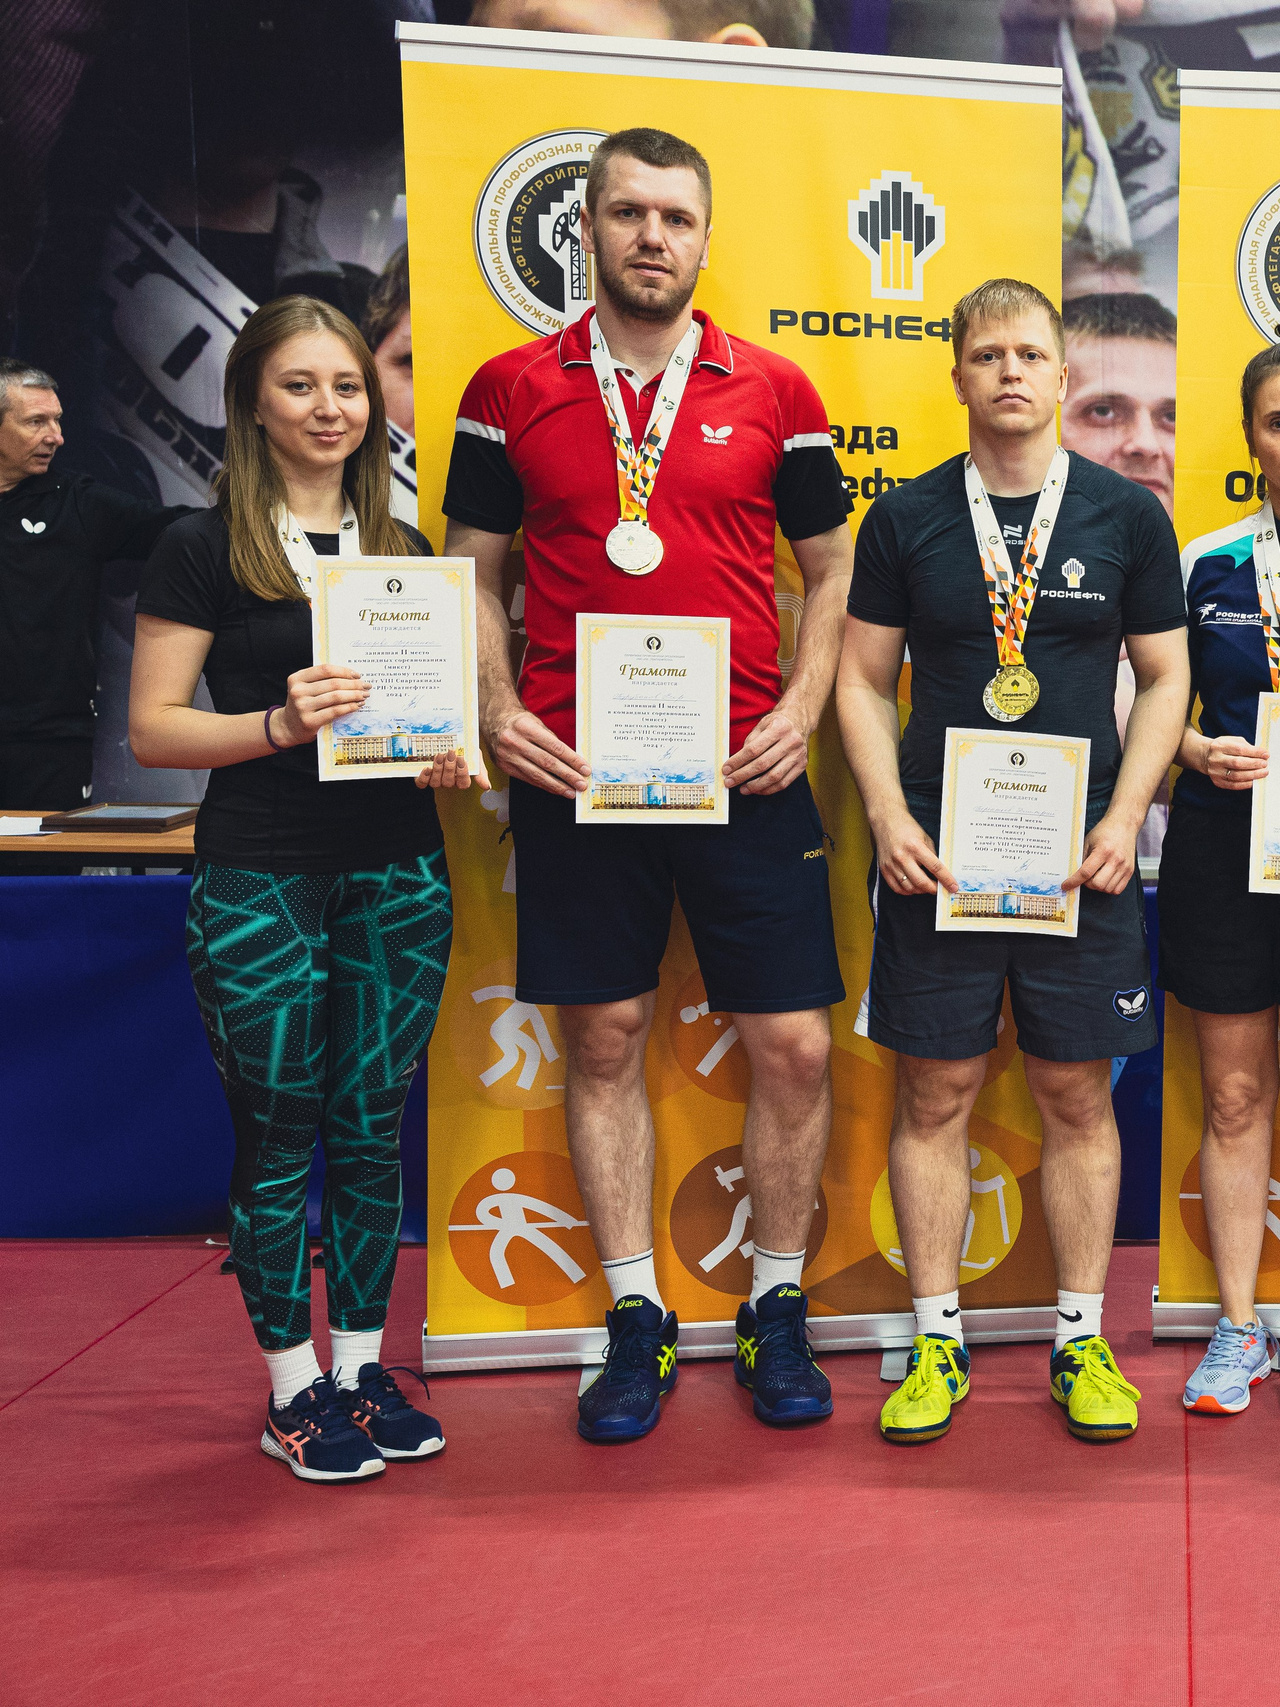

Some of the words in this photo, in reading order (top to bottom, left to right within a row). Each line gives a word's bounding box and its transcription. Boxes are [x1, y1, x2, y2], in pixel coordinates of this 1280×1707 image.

[493, 142, 583, 206] ПРОФСОЮЗНАЯ
[510, 165, 588, 288] НЕФТЕГАЗСТРОЙПР
[488, 208, 565, 331] МЕЖРЕГИОНАЛЬНАЯ
[1248, 239, 1279, 331] ЕГИОНАЛЬНАЯ
[770, 309, 952, 342] РОСНЕФ
[703, 435, 729, 446] Butterfly
[1040, 590, 1106, 602] РОСНЕФТЬ
[358, 609, 430, 626] Грамота
[620, 664, 687, 680] Грамота
[983, 778, 1047, 793] Грамота
[1012, 824, 1058, 832] соревнованиях
[1011, 842, 1051, 850] Спартакиады
[625, 1299, 643, 1308] asics
